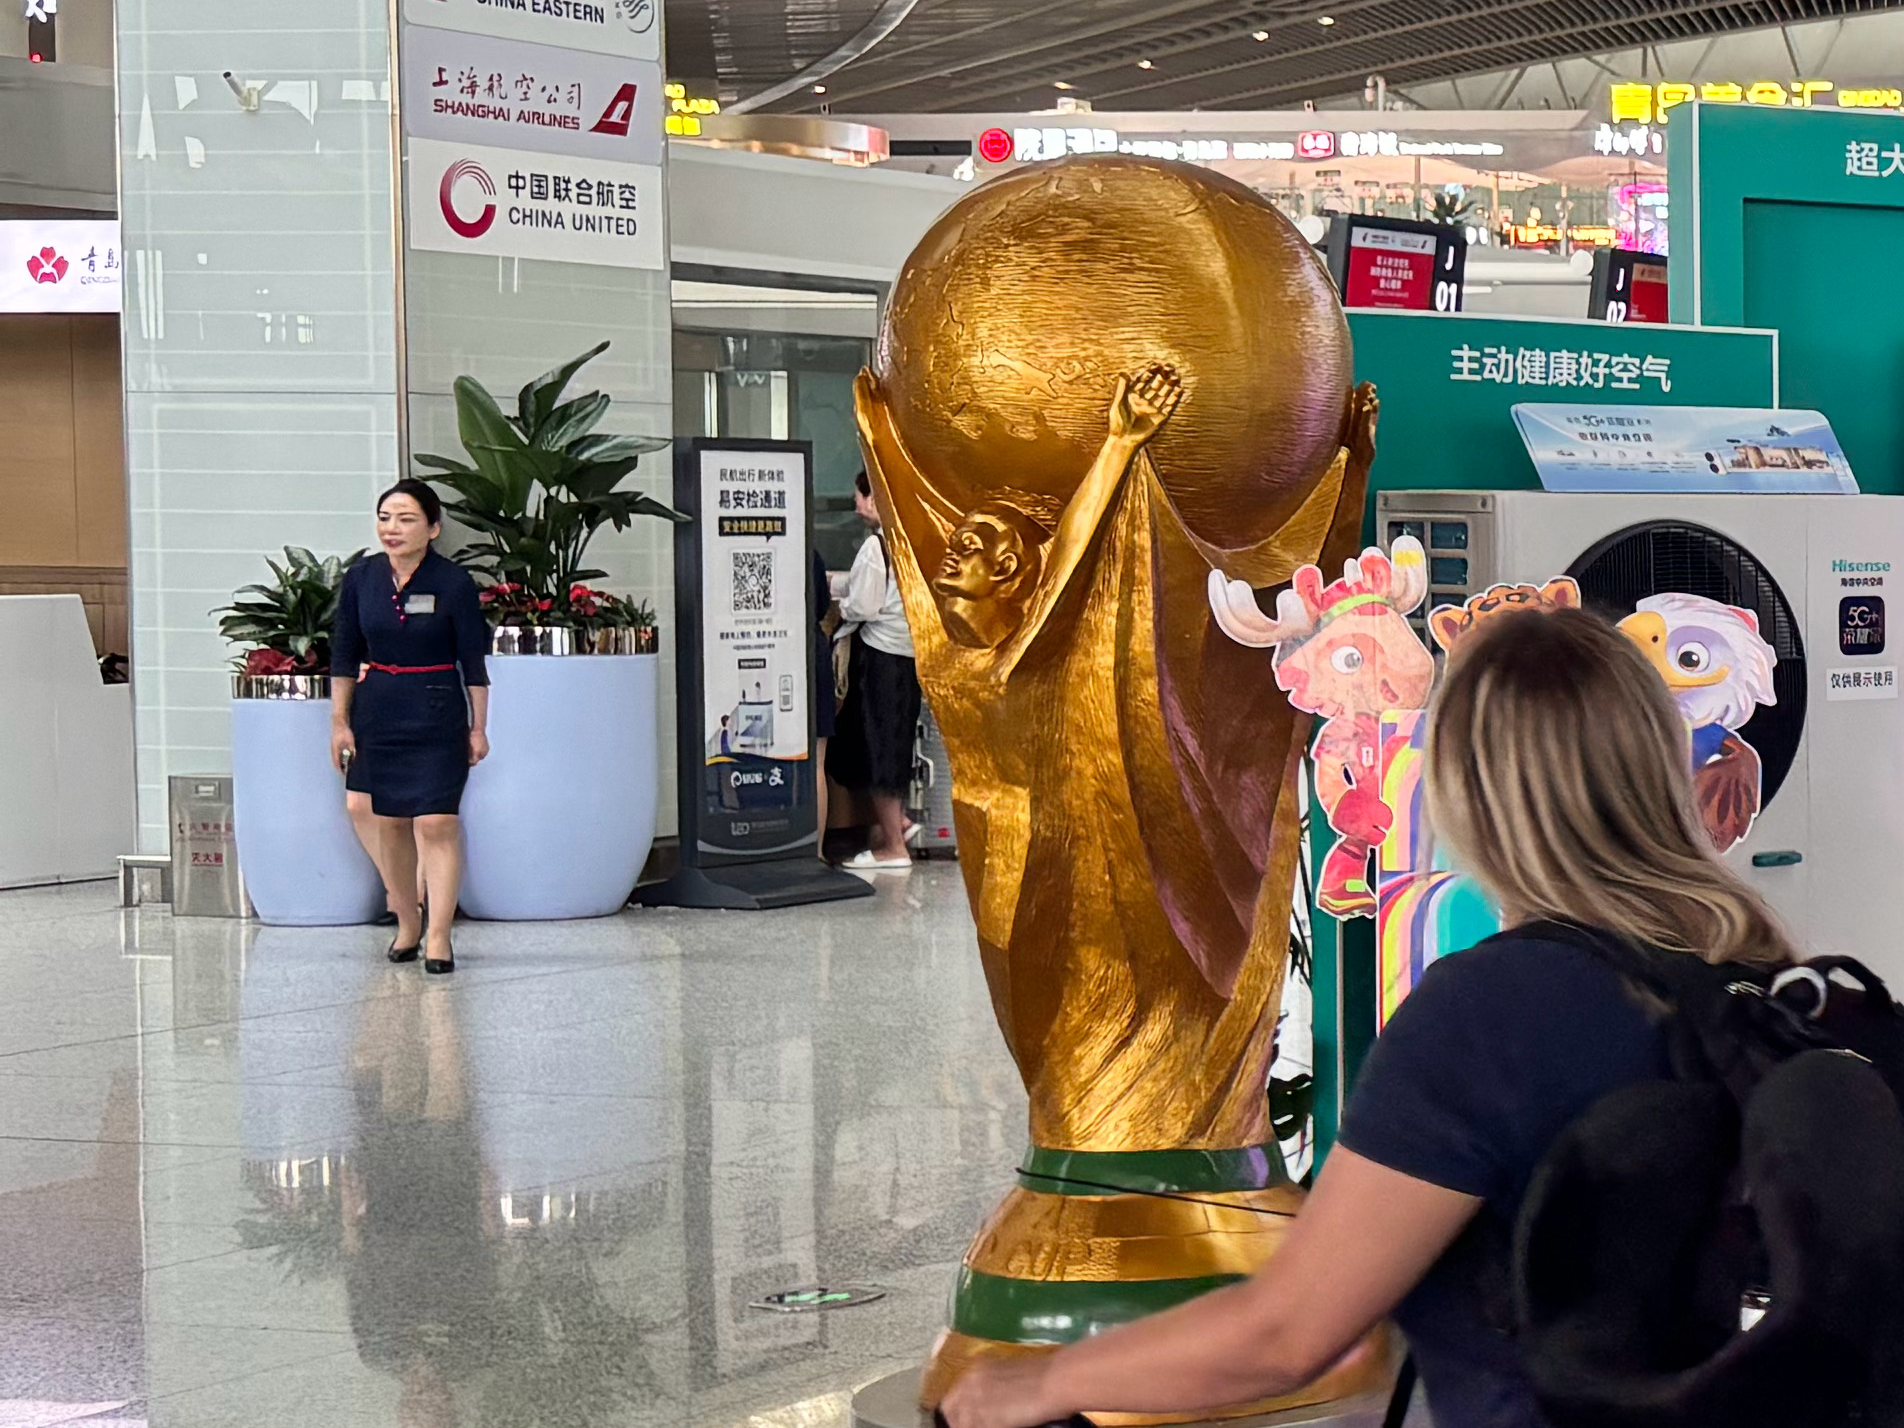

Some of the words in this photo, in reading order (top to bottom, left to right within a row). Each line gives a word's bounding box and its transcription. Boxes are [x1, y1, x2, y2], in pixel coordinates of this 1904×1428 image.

[432, 66, 582, 110] 上海航空公司
[433, 98, 511, 123] SHANGHAI
[516, 109, 581, 130] AIRLINES
[508, 170, 637, 211] 中国联合航空
[509, 206, 565, 231] CHINA
[572, 212, 637, 236] UNITED
[1445, 245, 1455, 271] J
[1616, 267, 1625, 291] J
[1435, 280, 1458, 312] 01
[1606, 300, 1627, 322] 02
[1450, 344, 1672, 392] 主动健康好空气
[1832, 560, 1891, 572] Hisense
[1830, 671, 1893, 689] 仅供展示使用
